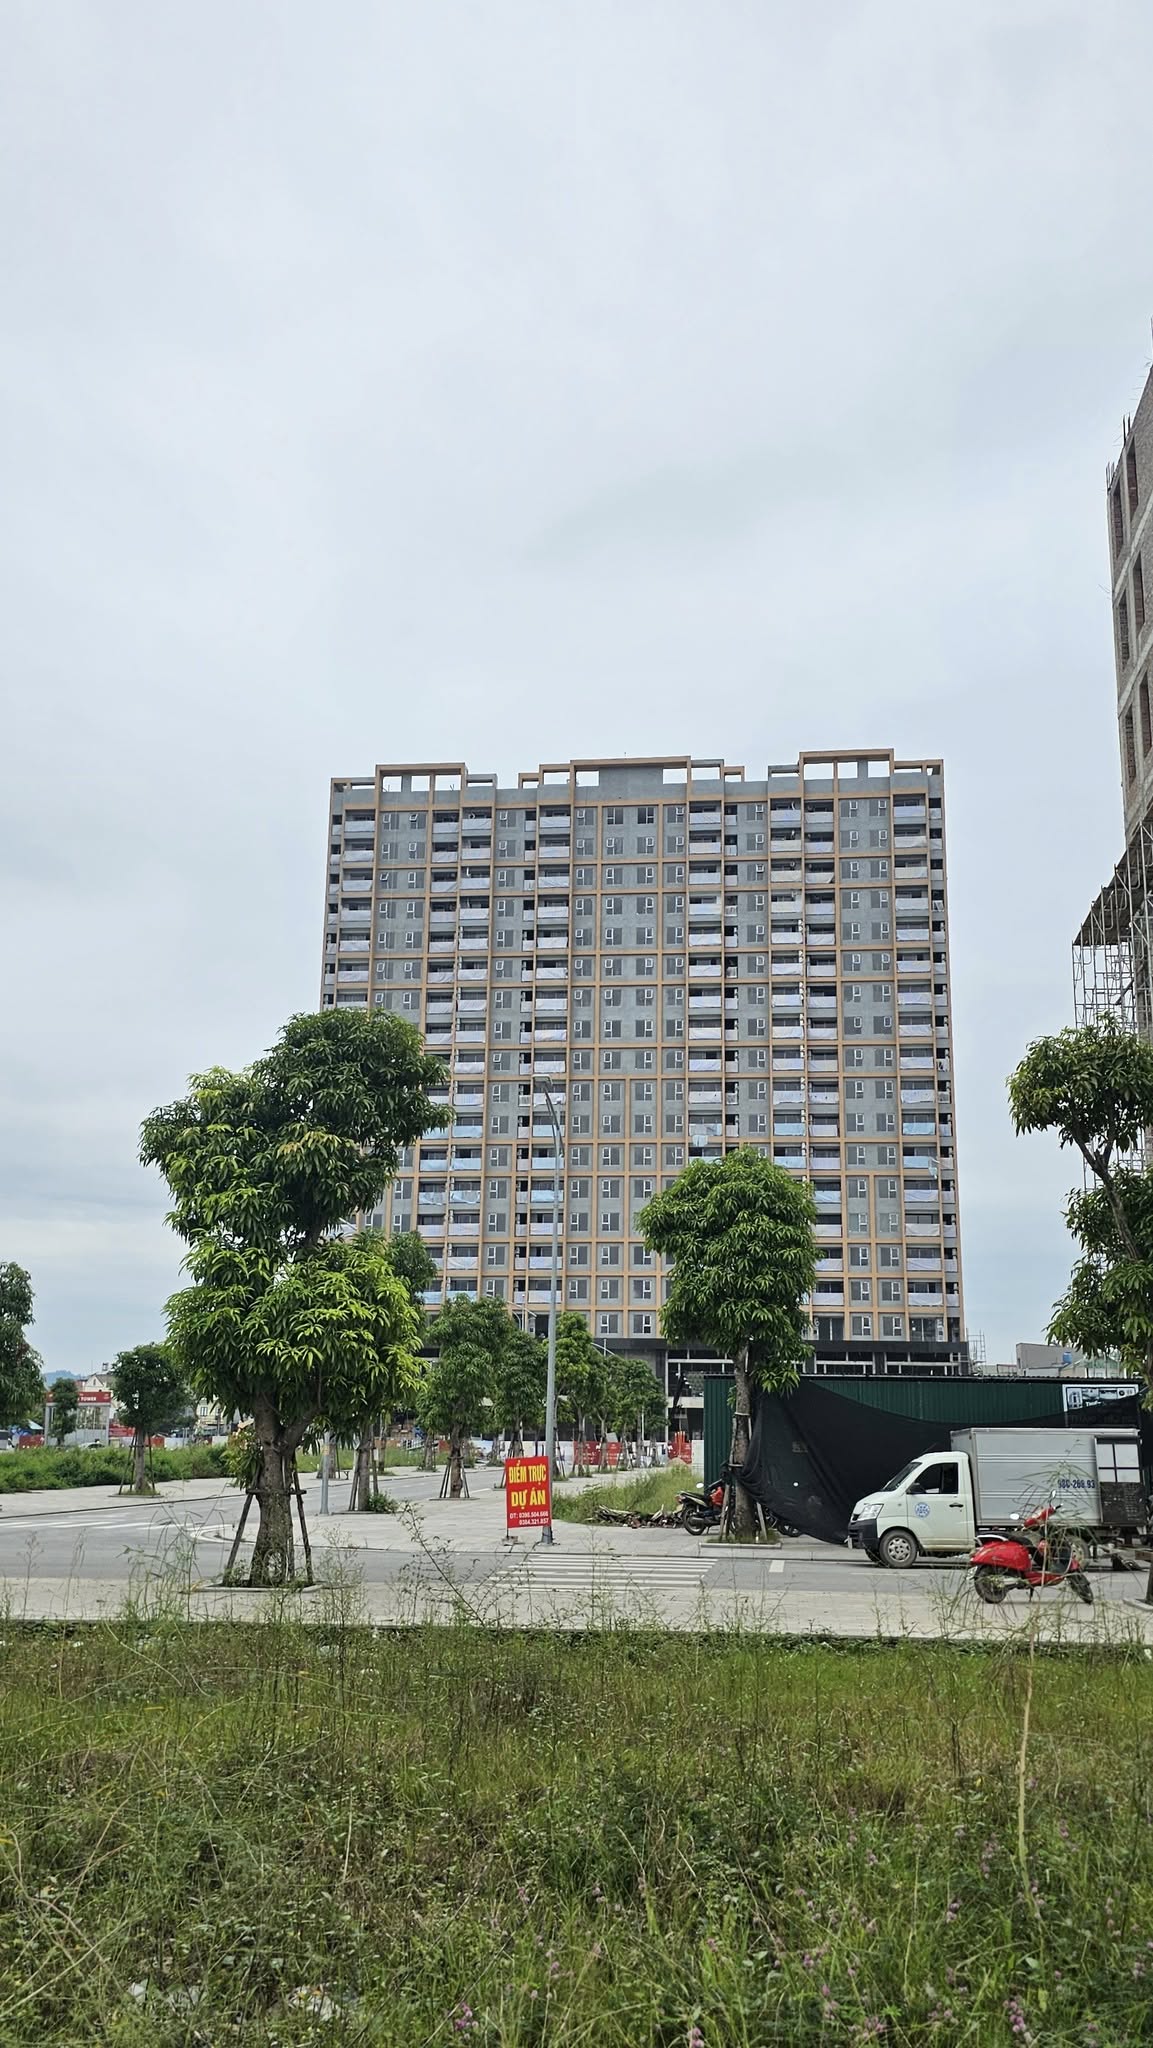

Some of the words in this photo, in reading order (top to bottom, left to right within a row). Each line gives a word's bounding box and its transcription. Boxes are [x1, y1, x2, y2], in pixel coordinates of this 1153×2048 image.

[528, 1463, 547, 1485] TRỰC
[511, 1490, 528, 1509] DỰ
[529, 1487, 546, 1505] ÁN
